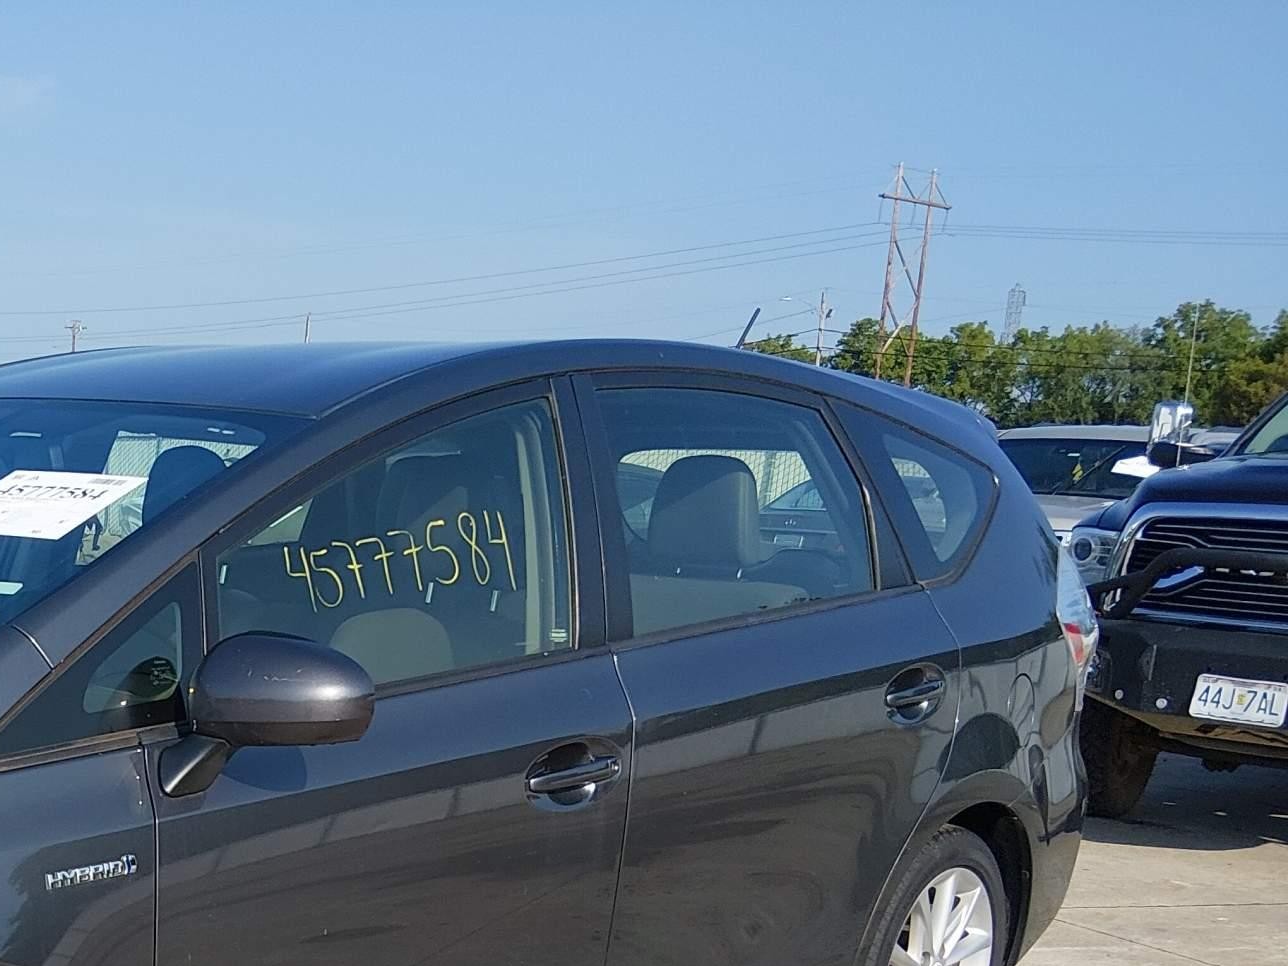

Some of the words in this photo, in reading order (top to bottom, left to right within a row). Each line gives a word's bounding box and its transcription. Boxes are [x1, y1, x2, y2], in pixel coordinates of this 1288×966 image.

[0, 483, 110, 500] 45777584
[282, 509, 517, 613] 45777584
[1197, 685, 1237, 710] 44J
[1243, 690, 1280, 716] 7AL
[44, 859, 127, 890] HYBRID
